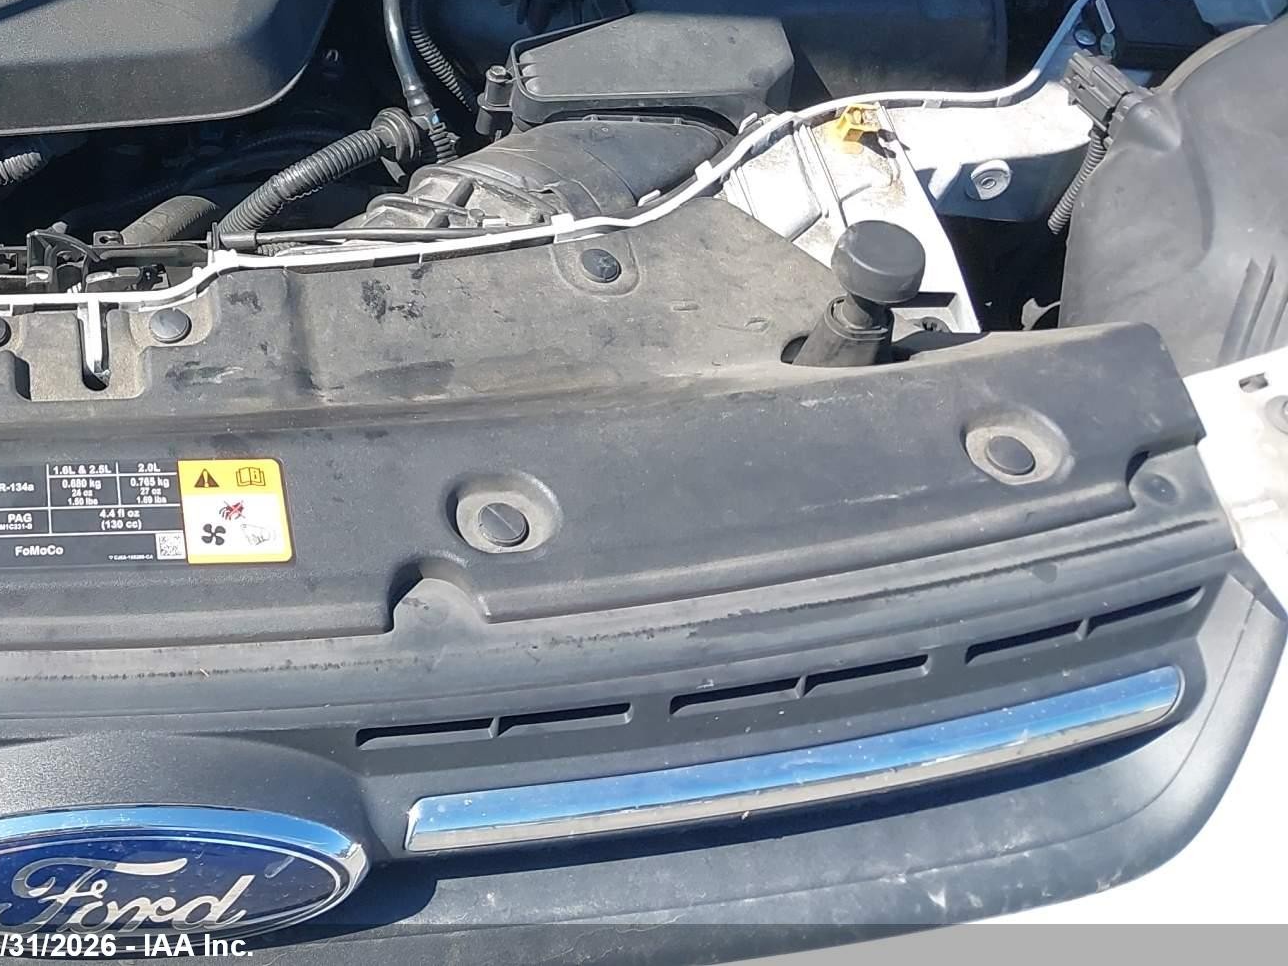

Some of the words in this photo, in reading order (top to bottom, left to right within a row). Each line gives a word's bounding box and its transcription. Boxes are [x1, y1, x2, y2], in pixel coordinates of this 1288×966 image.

[78, 466, 86, 474] &
[88, 464, 112, 474] 2.5L
[138, 463, 160, 472] 2.0L
[89, 478, 102, 490] kg
[130, 477, 156, 487] 0.765
[157, 477, 170, 488] kg
[140, 487, 150, 496] 27
[8, 514, 32, 523] PAG
[99, 510, 116, 518] 4.4
[117, 509, 126, 518] fl
[127, 510, 140, 518] oz
[101, 520, 123, 530] (130
[126, 519, 142, 530] cc)
[15, 545, 64, 556] FoMoCo
